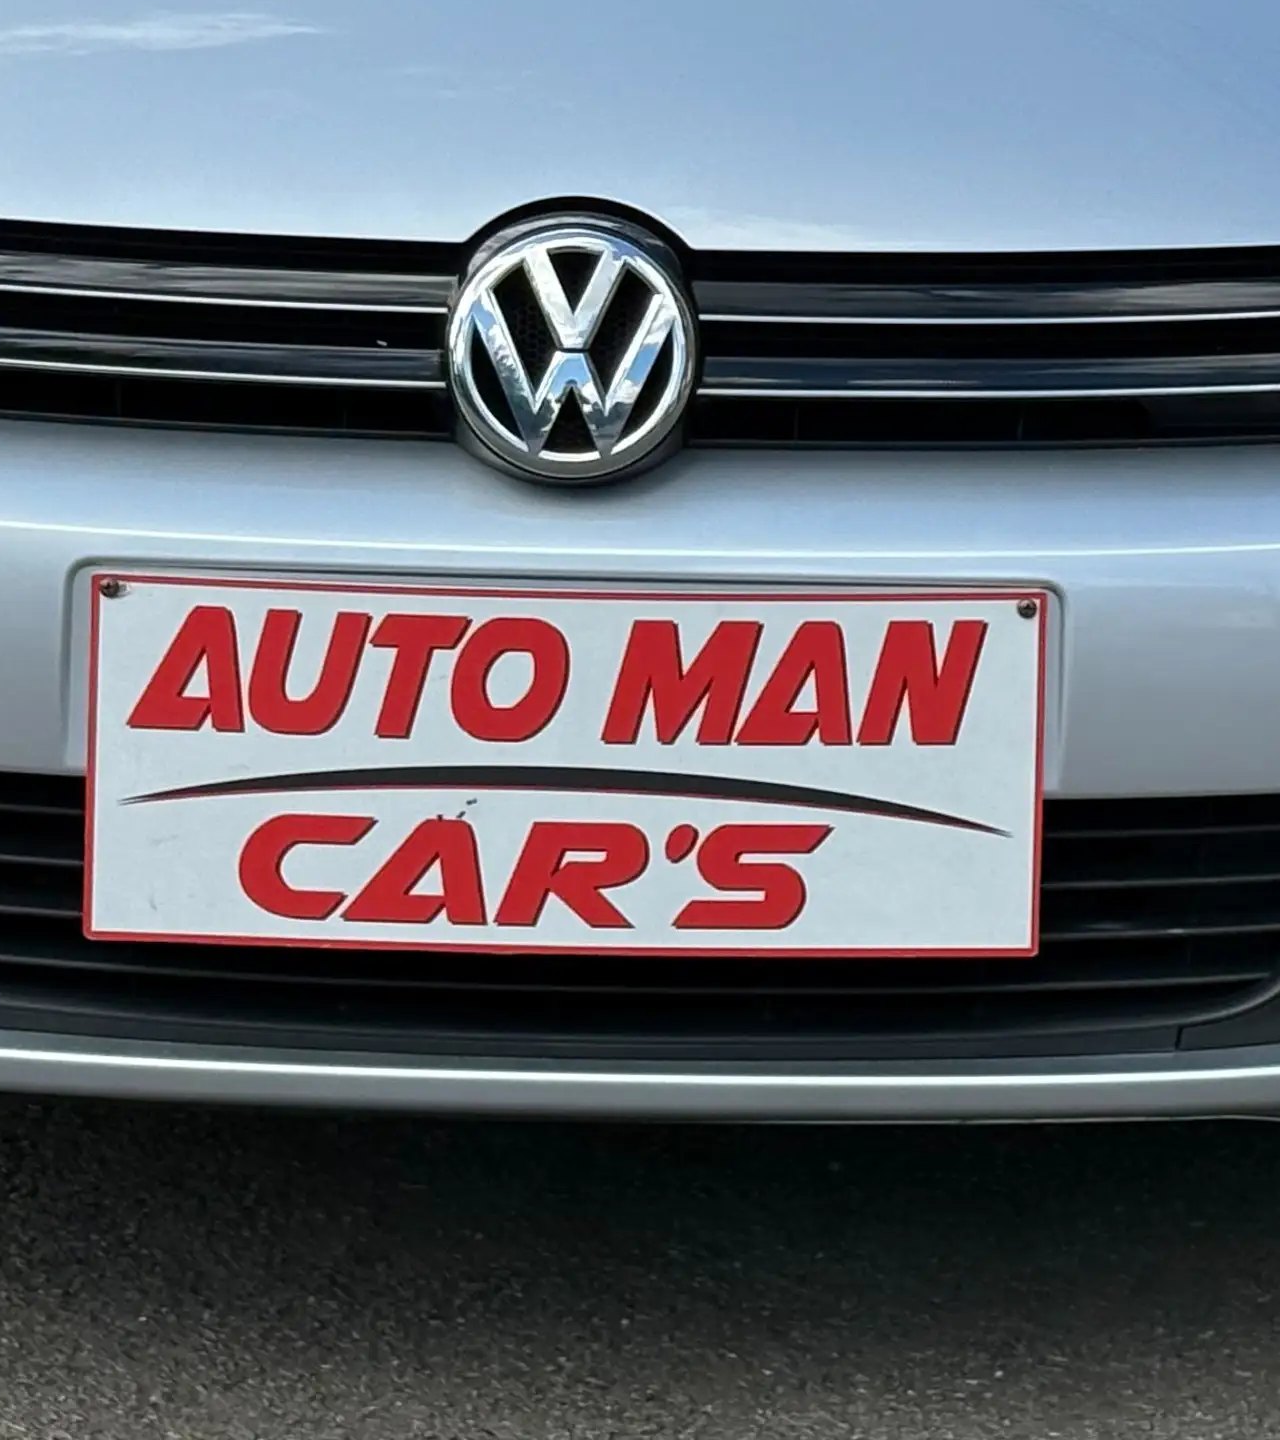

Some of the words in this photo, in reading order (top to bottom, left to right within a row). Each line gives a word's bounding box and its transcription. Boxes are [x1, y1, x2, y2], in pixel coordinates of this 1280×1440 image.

[127, 605, 570, 743] AUTO
[601, 618, 989, 748] MAN
[237, 811, 835, 931] CAR'S
